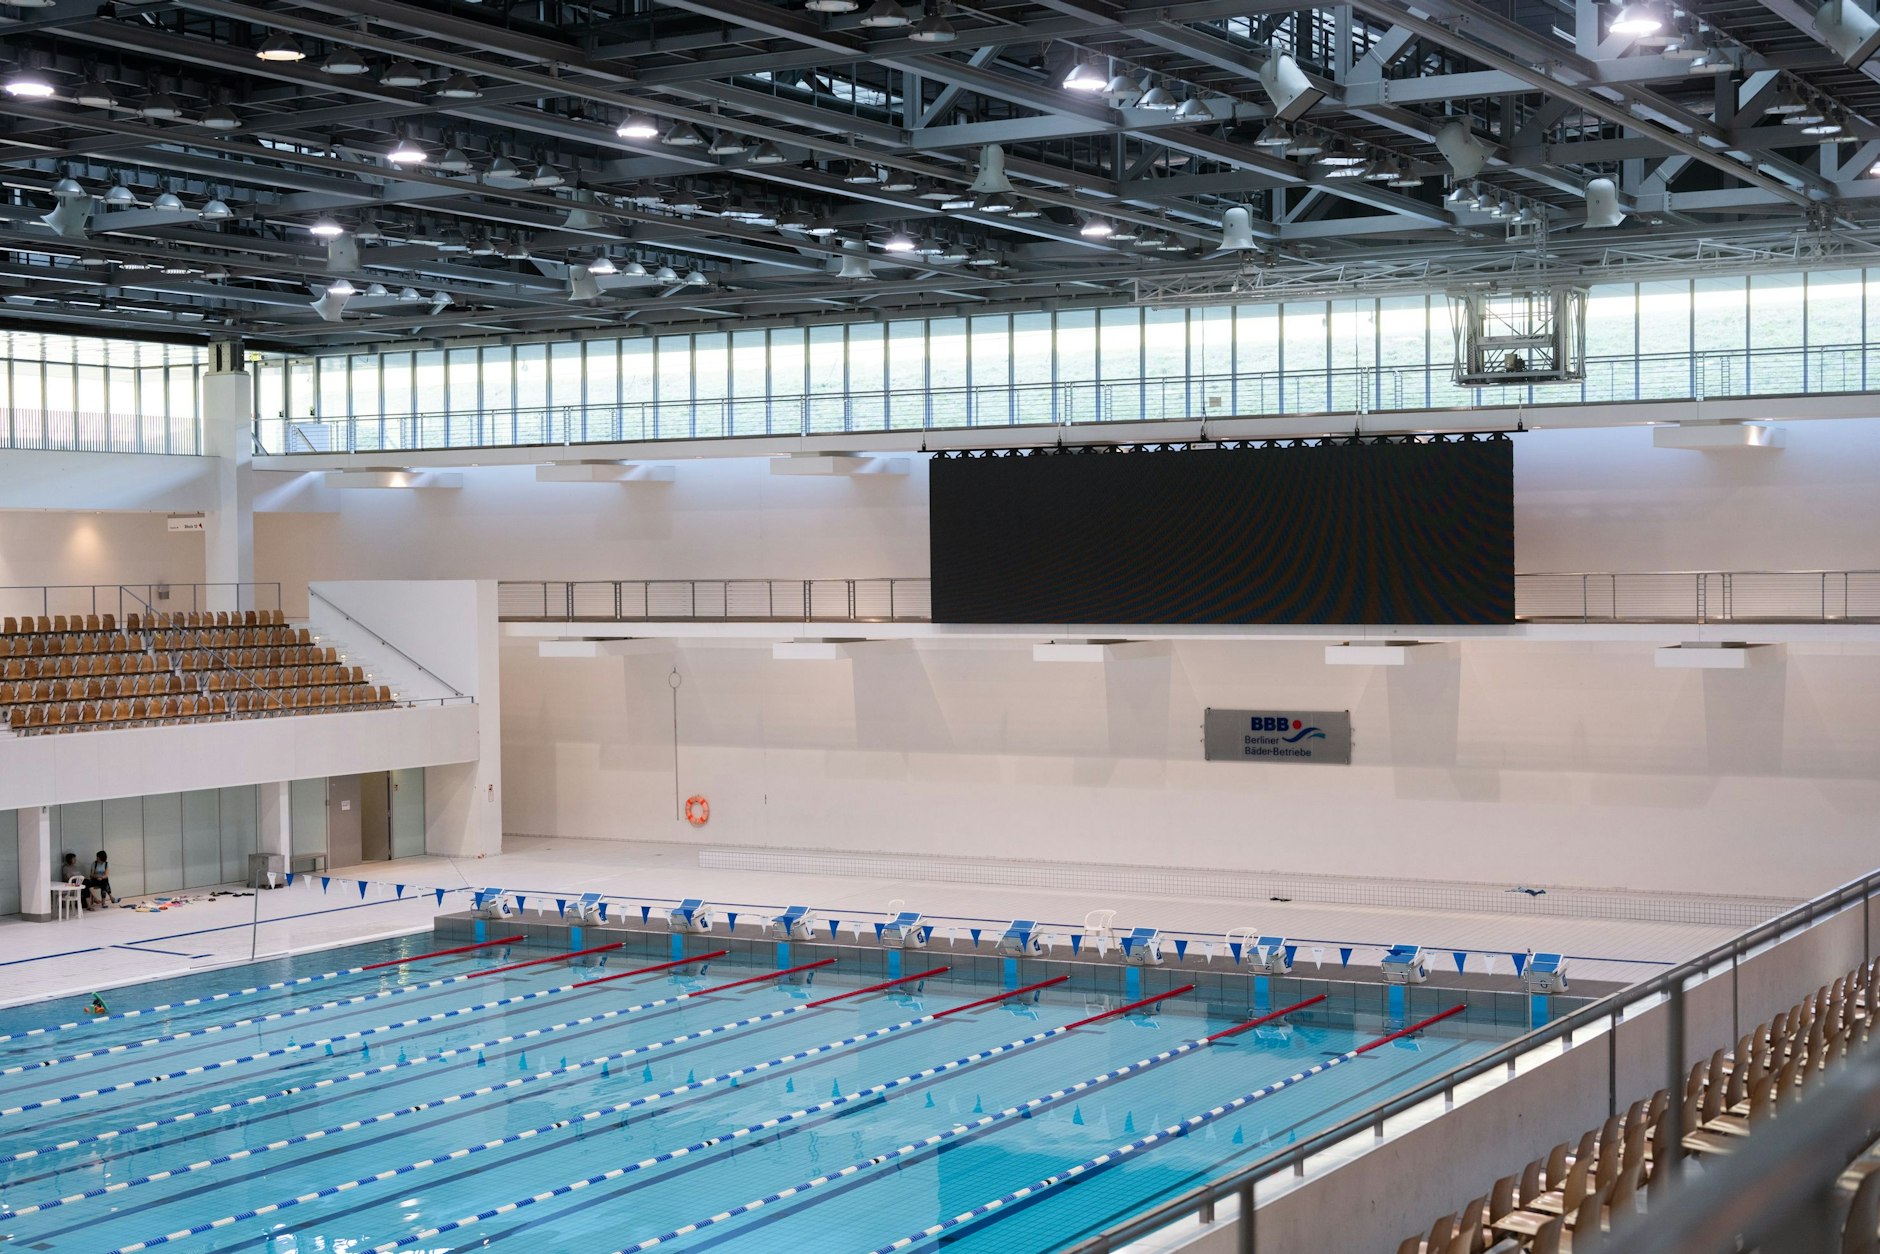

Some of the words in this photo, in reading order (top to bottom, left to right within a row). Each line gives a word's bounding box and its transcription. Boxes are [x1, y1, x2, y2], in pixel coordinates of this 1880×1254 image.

[1251, 717, 1289, 731] BBB
[1244, 735, 1279, 745] Berliner
[1244, 746, 1312, 757] Bäder-Betriebe
